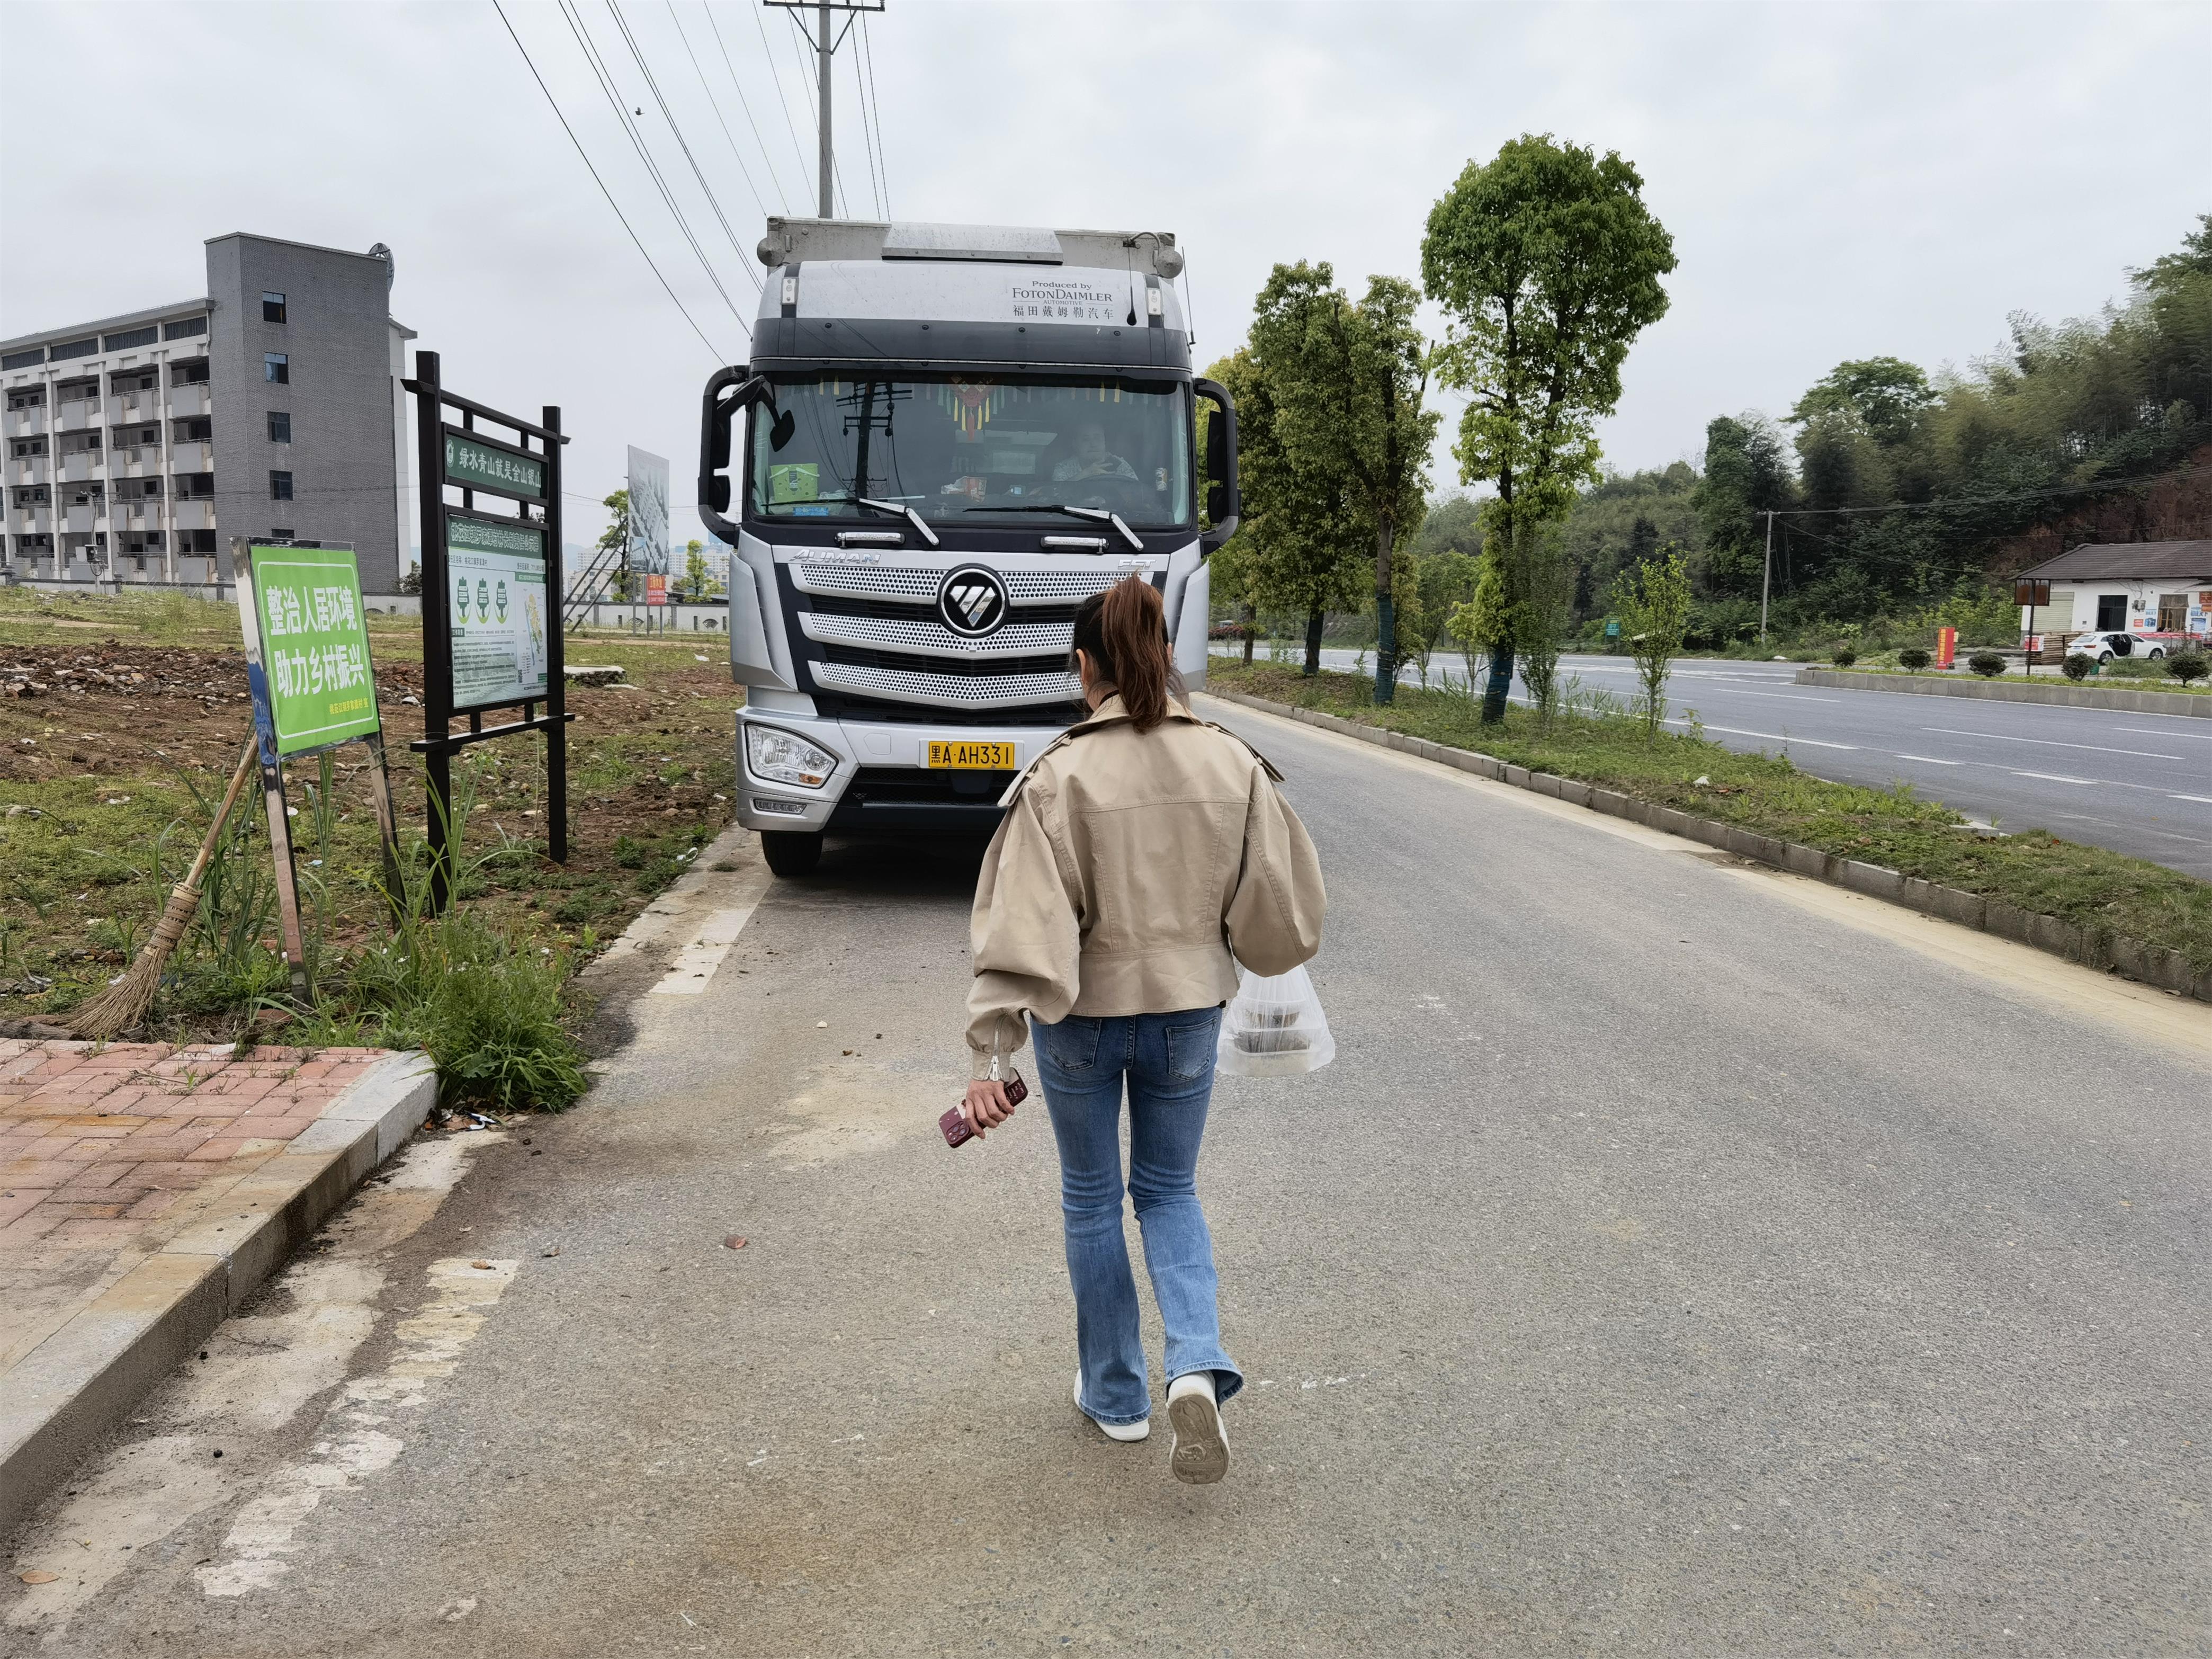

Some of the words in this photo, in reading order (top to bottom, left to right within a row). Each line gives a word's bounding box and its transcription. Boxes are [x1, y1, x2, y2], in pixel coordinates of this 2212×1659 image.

[1013, 305, 1114, 319] 福田戴姆勒汽车
[459, 447, 542, 489] 绿水青山就是金山银山
[790, 549, 881, 565] AUMAN
[265, 585, 357, 636] 整治人居环境
[274, 643, 365, 699] 助力乡村振兴
